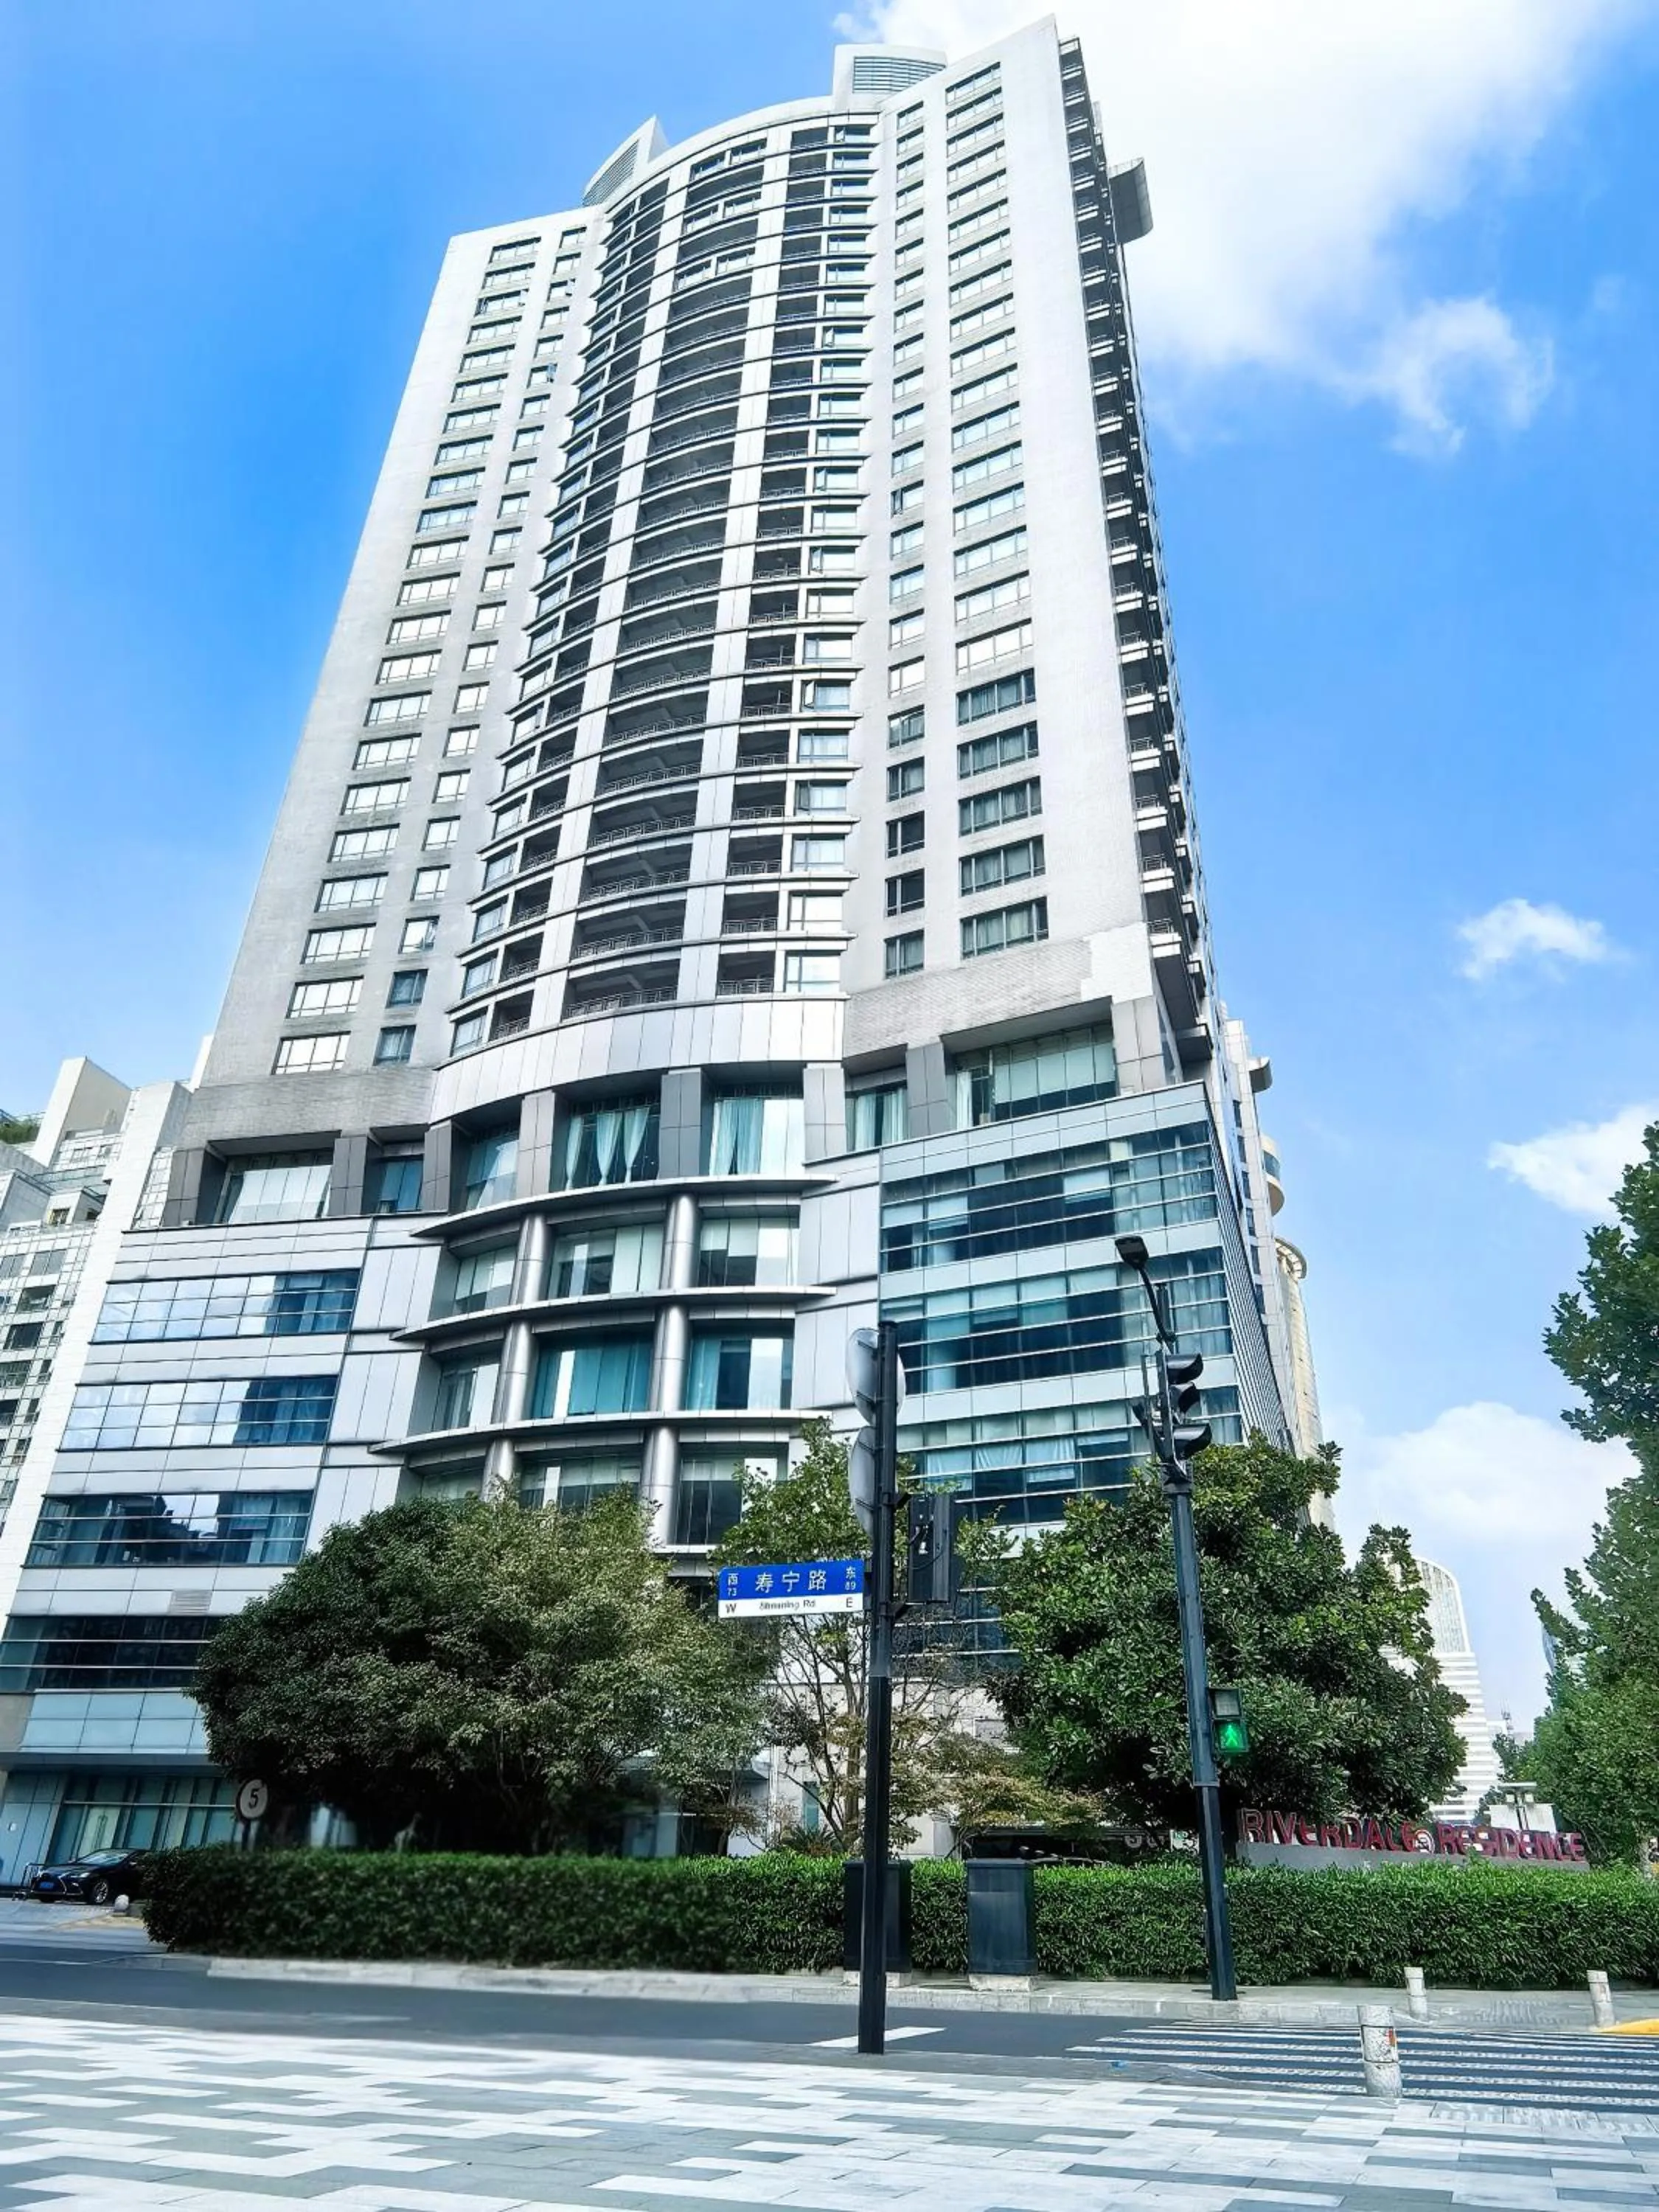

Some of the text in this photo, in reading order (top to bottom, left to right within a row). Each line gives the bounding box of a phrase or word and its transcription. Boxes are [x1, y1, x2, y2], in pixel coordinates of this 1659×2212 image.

[755, 1569, 827, 1593] 寿宁路
[726, 1603, 737, 1613] W
[803, 1599, 815, 1608] Rd
[846, 1596, 853, 1608] E
[248, 1787, 259, 1809] 5
